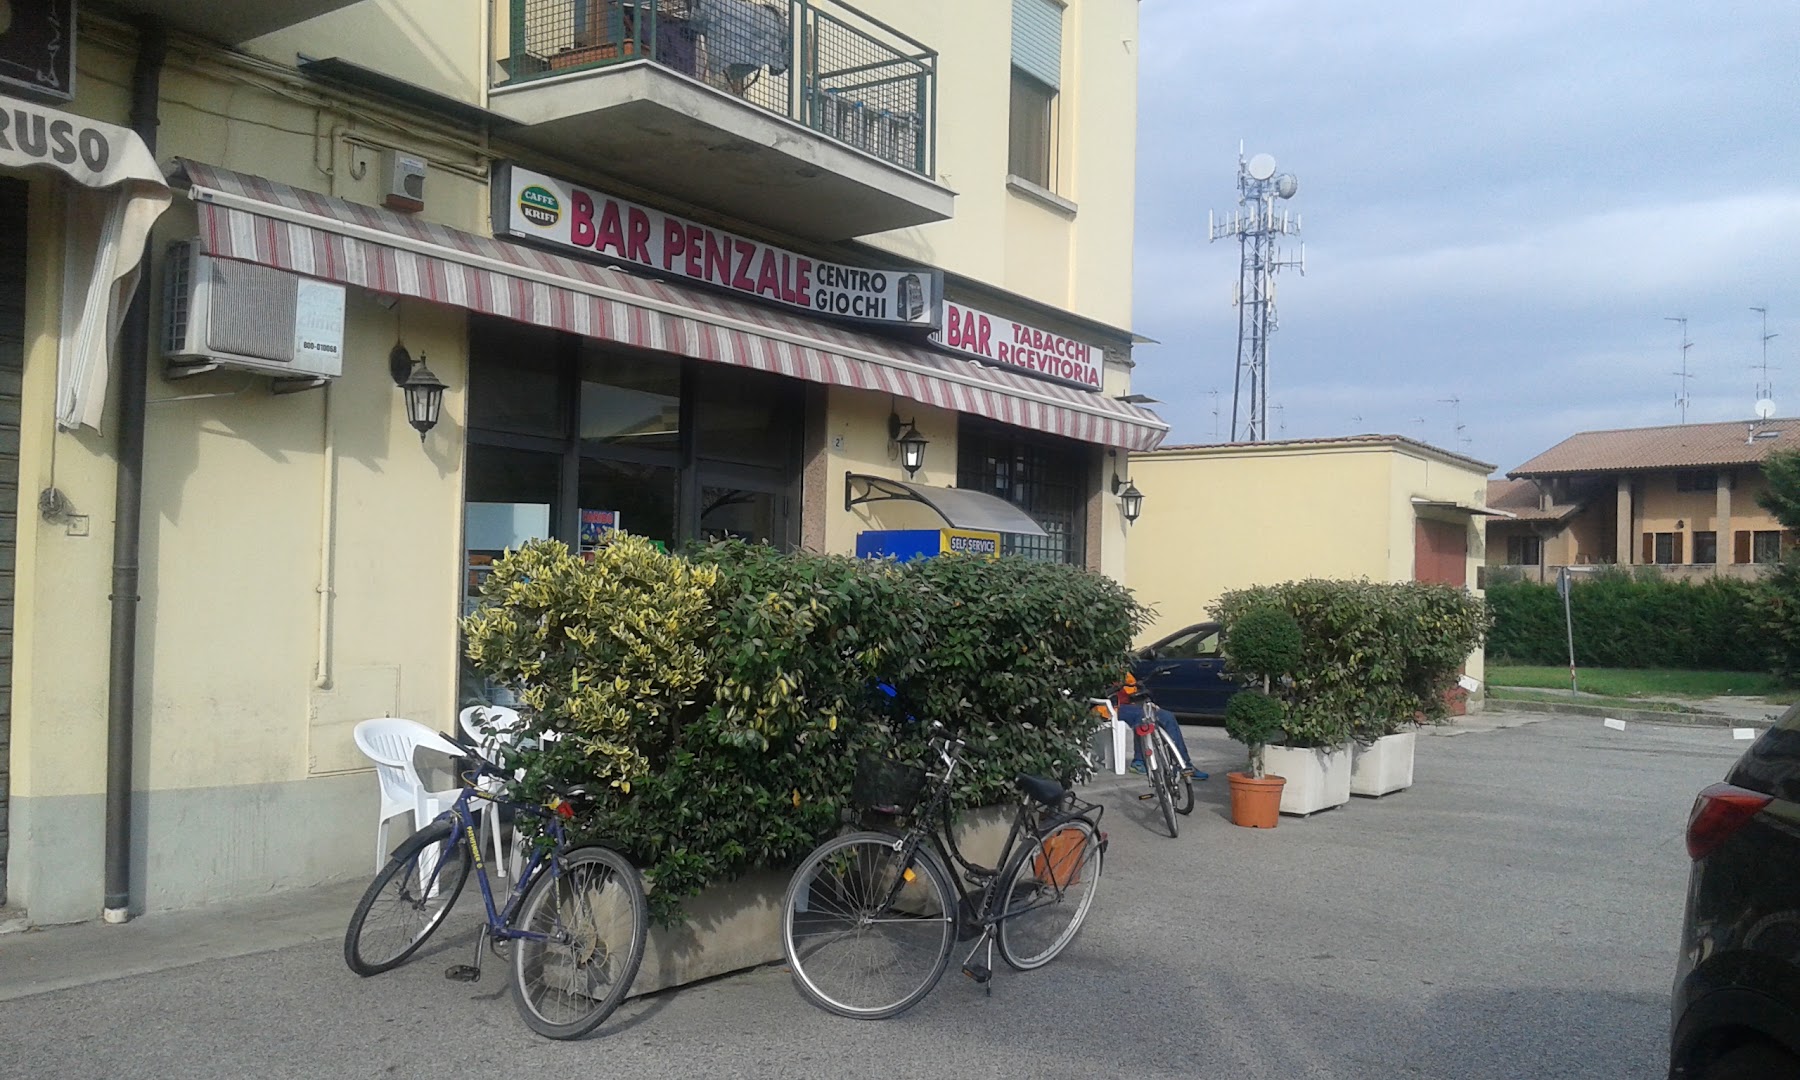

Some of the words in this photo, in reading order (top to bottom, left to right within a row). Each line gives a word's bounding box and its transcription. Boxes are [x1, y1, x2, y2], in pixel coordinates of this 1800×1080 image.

[524, 207, 555, 222] KRIFI
[571, 188, 652, 265] BAR
[663, 216, 812, 306] PENZALE
[816, 263, 887, 293] CENTRO
[815, 289, 887, 318] GIOCHI
[947, 304, 992, 356] BAR
[1011, 322, 1091, 364] TABACCHI
[998, 341, 1100, 386] RICEVITORIA
[951, 537, 967, 551] SELF
[968, 538, 995, 552] SERVICE
